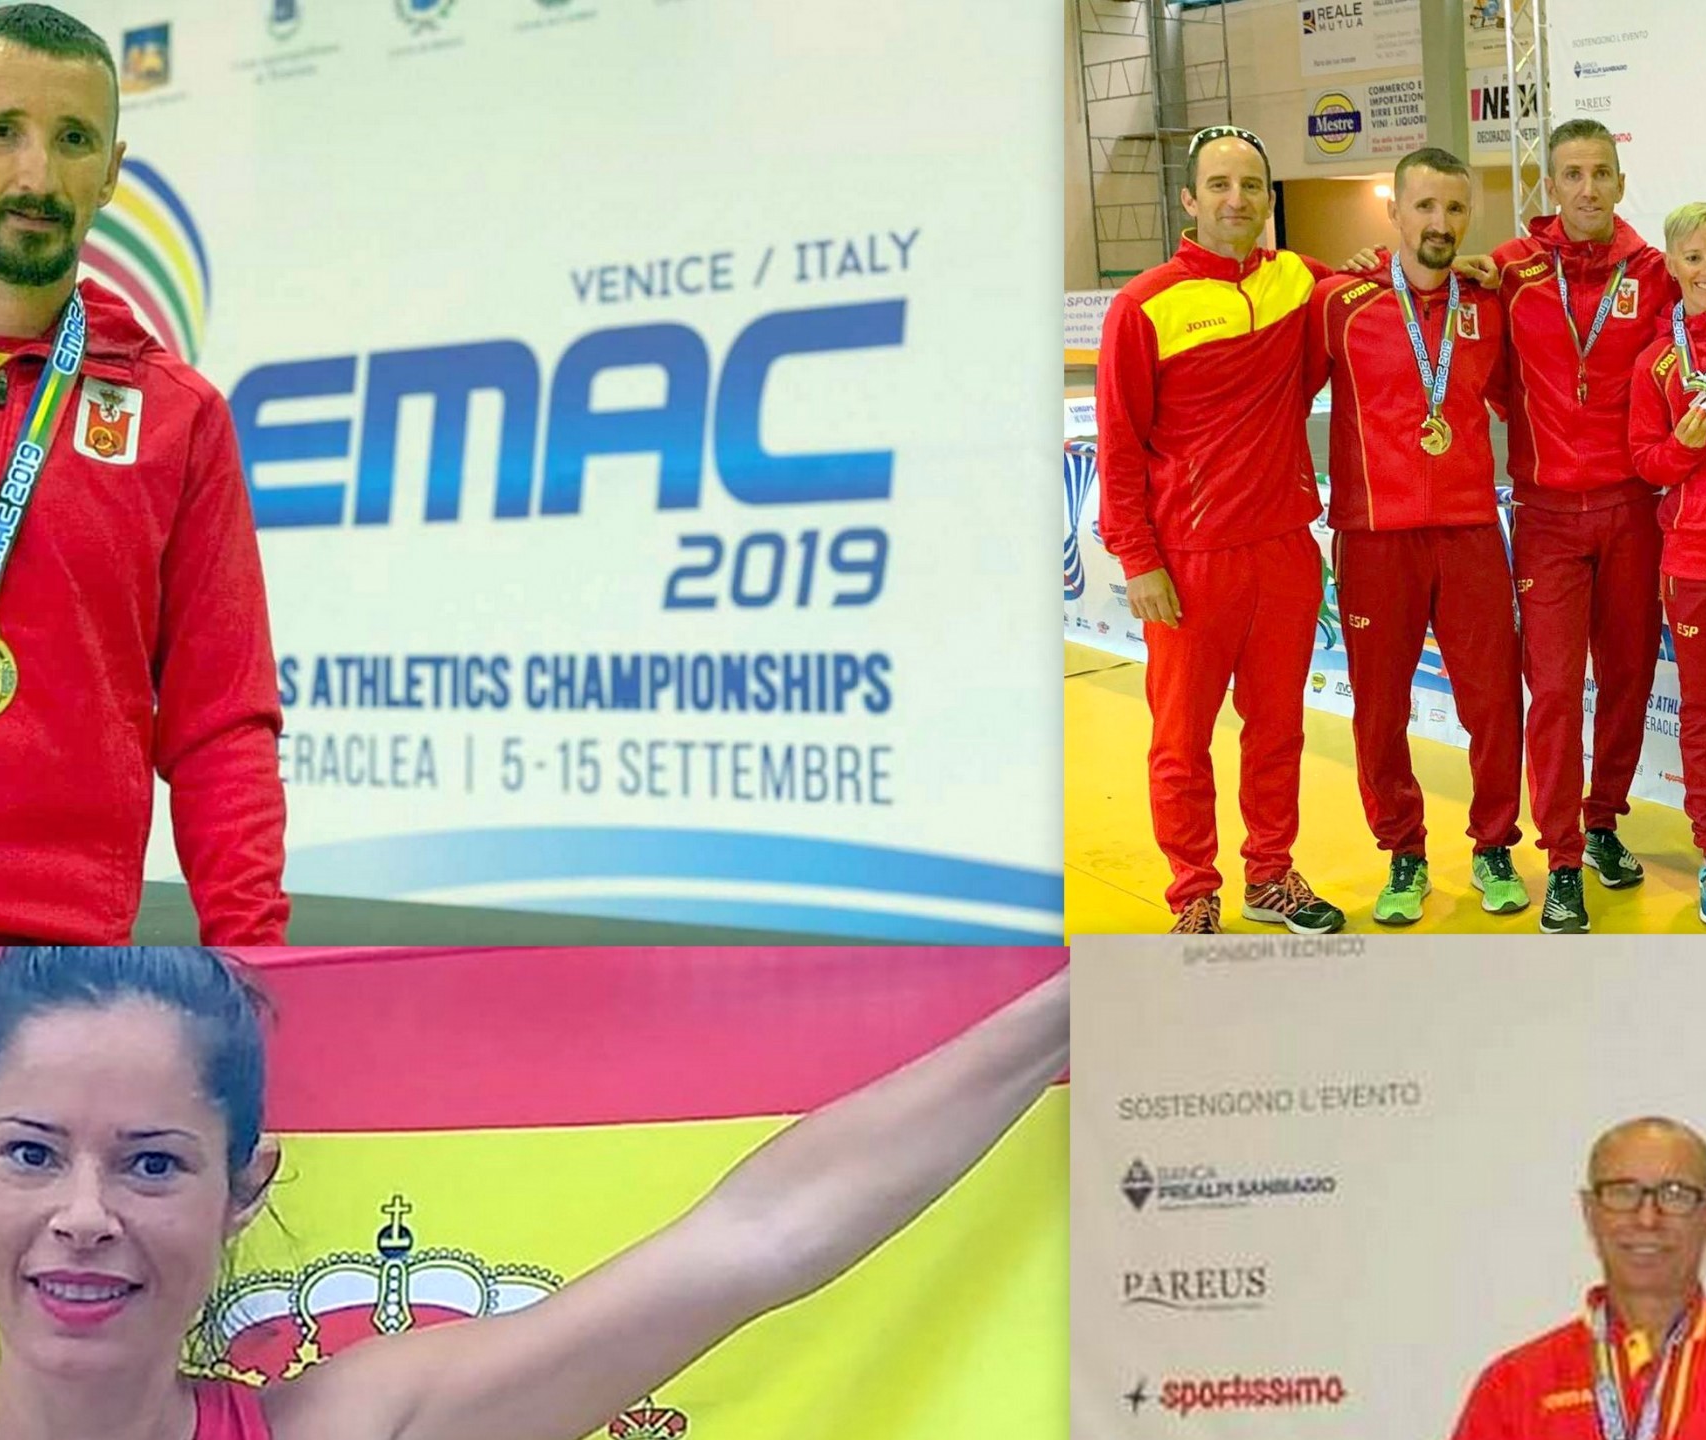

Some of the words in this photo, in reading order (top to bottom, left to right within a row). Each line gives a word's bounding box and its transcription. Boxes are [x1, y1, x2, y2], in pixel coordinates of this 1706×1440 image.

[1318, 2, 1363, 19] REALE
[1318, 18, 1364, 32] MUTUA
[1368, 82, 1416, 96] COMMERCIO
[1315, 115, 1355, 133] Mestre
[1371, 118, 1388, 129] VINI
[570, 251, 734, 305] VENICE
[794, 229, 922, 282] ITALY
[1341, 280, 1379, 304] Joma
[1185, 316, 1227, 334] Joma
[229, 298, 908, 530] EMAC
[662, 527, 892, 612] 2019
[1348, 613, 1370, 630] ESP
[1676, 622, 1699, 639] ESP
[311, 653, 511, 711] ATHLETICS
[524, 651, 893, 716] CHAMPIONSHIPS
[617, 740, 894, 805] SETTEMBRE
[1183, 938, 1275, 966] SPONSOR
[1289, 935, 1366, 961] TECNICO
[1117, 1088, 1293, 1122] SOSTENGONO
[1299, 1080, 1422, 1111] L'EVENTO
[1123, 1266, 1267, 1301] PAREUS
[1159, 1373, 1345, 1418] sportissimo
